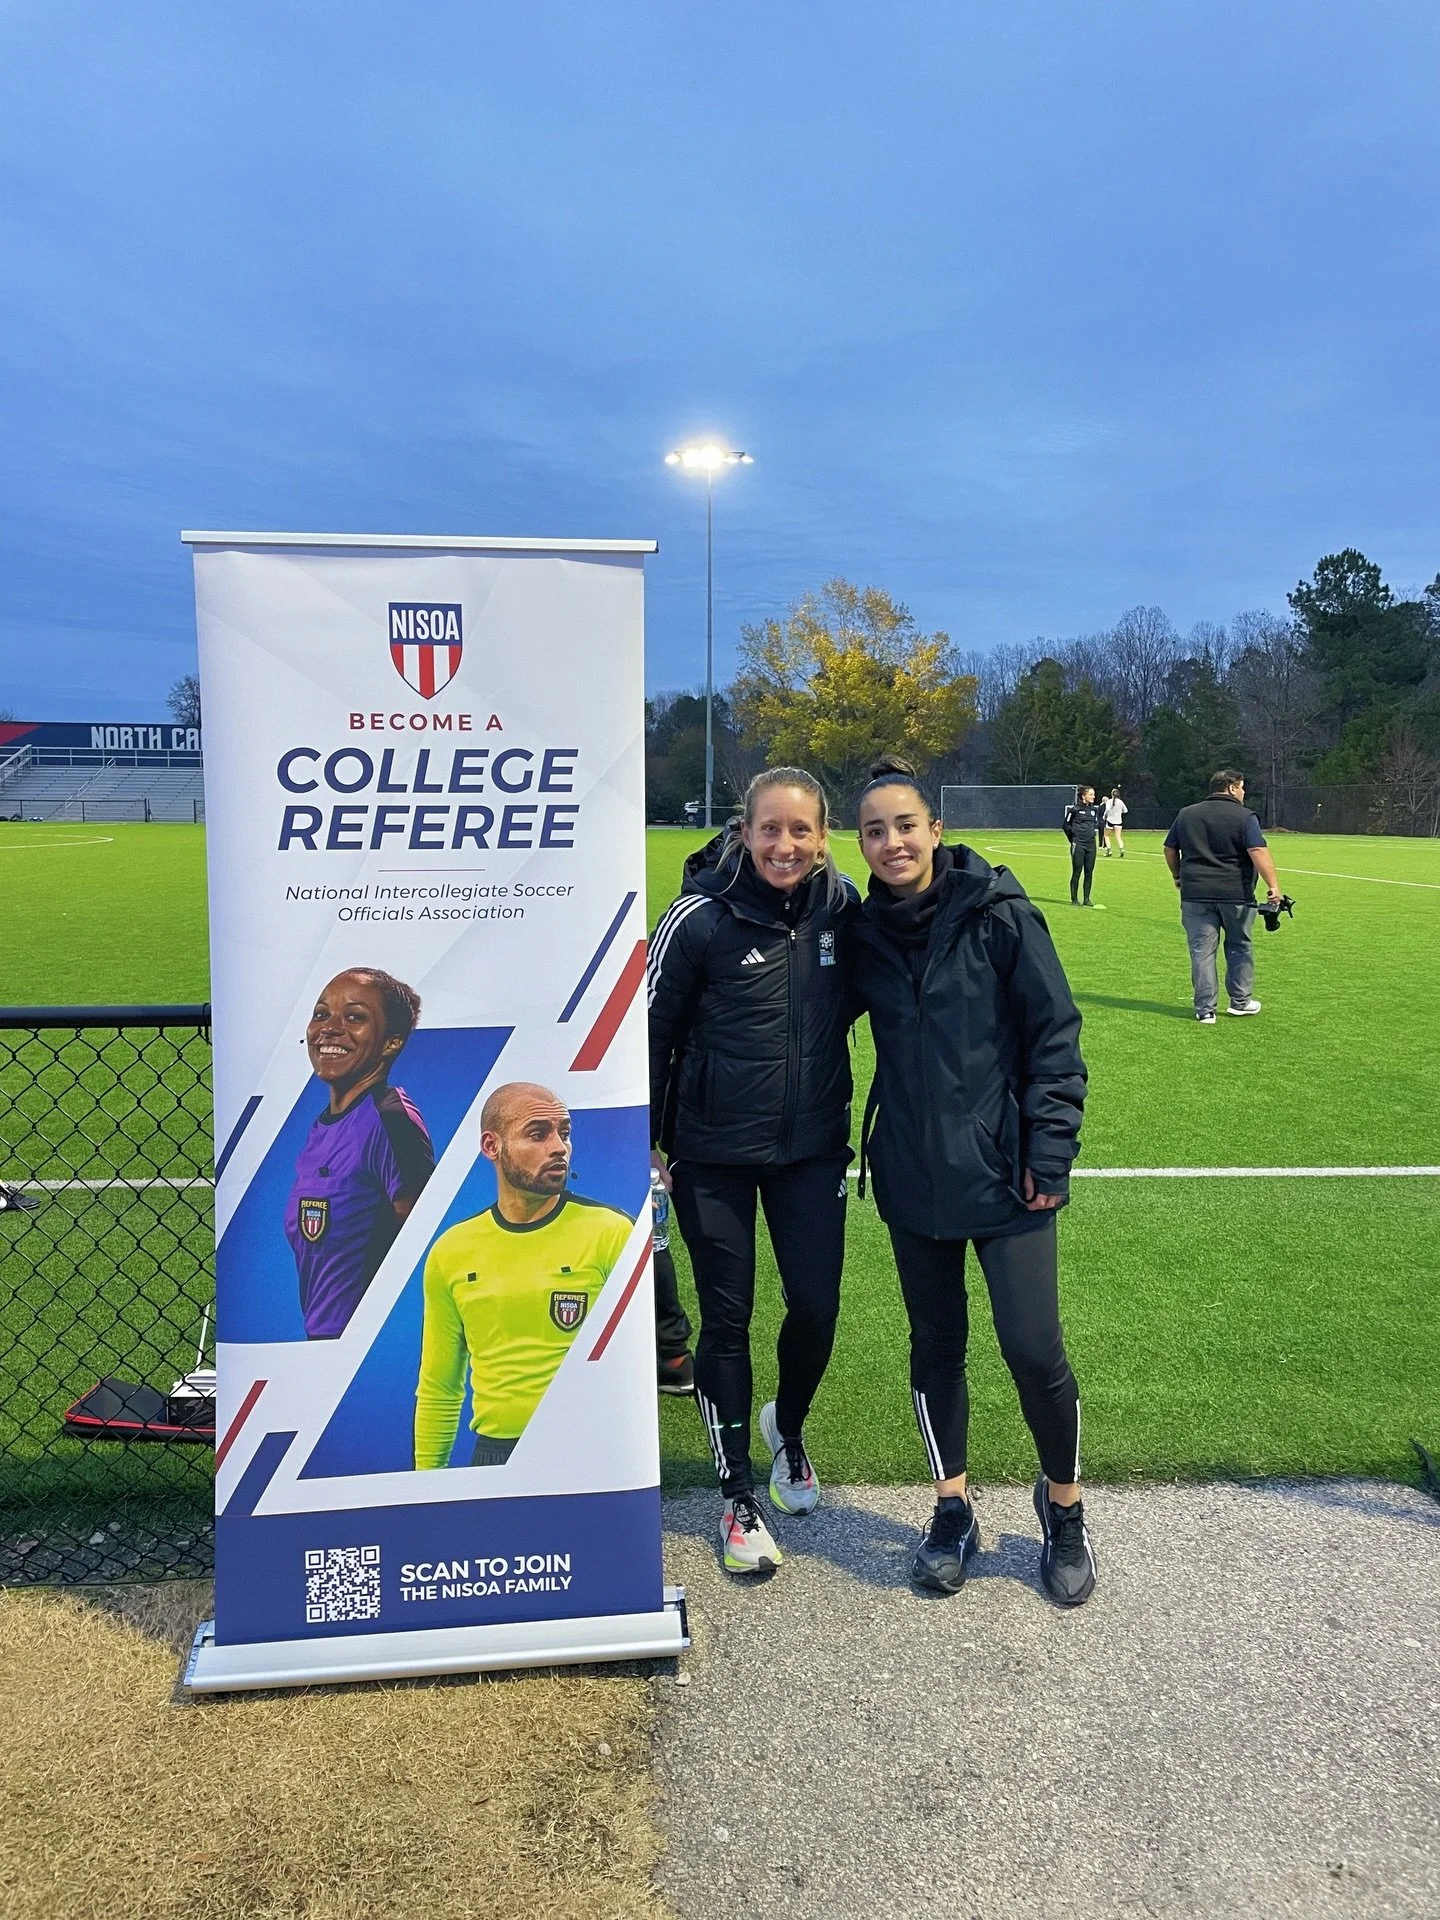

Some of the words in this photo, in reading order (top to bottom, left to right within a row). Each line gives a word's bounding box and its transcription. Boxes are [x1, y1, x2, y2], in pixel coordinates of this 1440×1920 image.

[391, 609, 460, 640] NISOA
[349, 712, 472, 732] BECOME
[486, 714, 504, 732] A
[91, 726, 162, 750] NORTH
[276, 747, 579, 793] COLLEGE
[277, 804, 580, 850] REFEREE
[285, 885, 369, 901] National
[373, 884, 510, 903] Intercollegiate
[512, 882, 574, 898] Soccer
[337, 905, 414, 922] Officials
[418, 904, 525, 920] Association
[554, 1294, 585, 1302] REFEREE
[400, 1560, 469, 1583] SCAN
[475, 1558, 508, 1577] TO
[513, 1553, 571, 1574] JOIN
[400, 1586, 438, 1601] THE
[442, 1581, 501, 1598] NISOA
[505, 1575, 573, 1594] FAMILY
